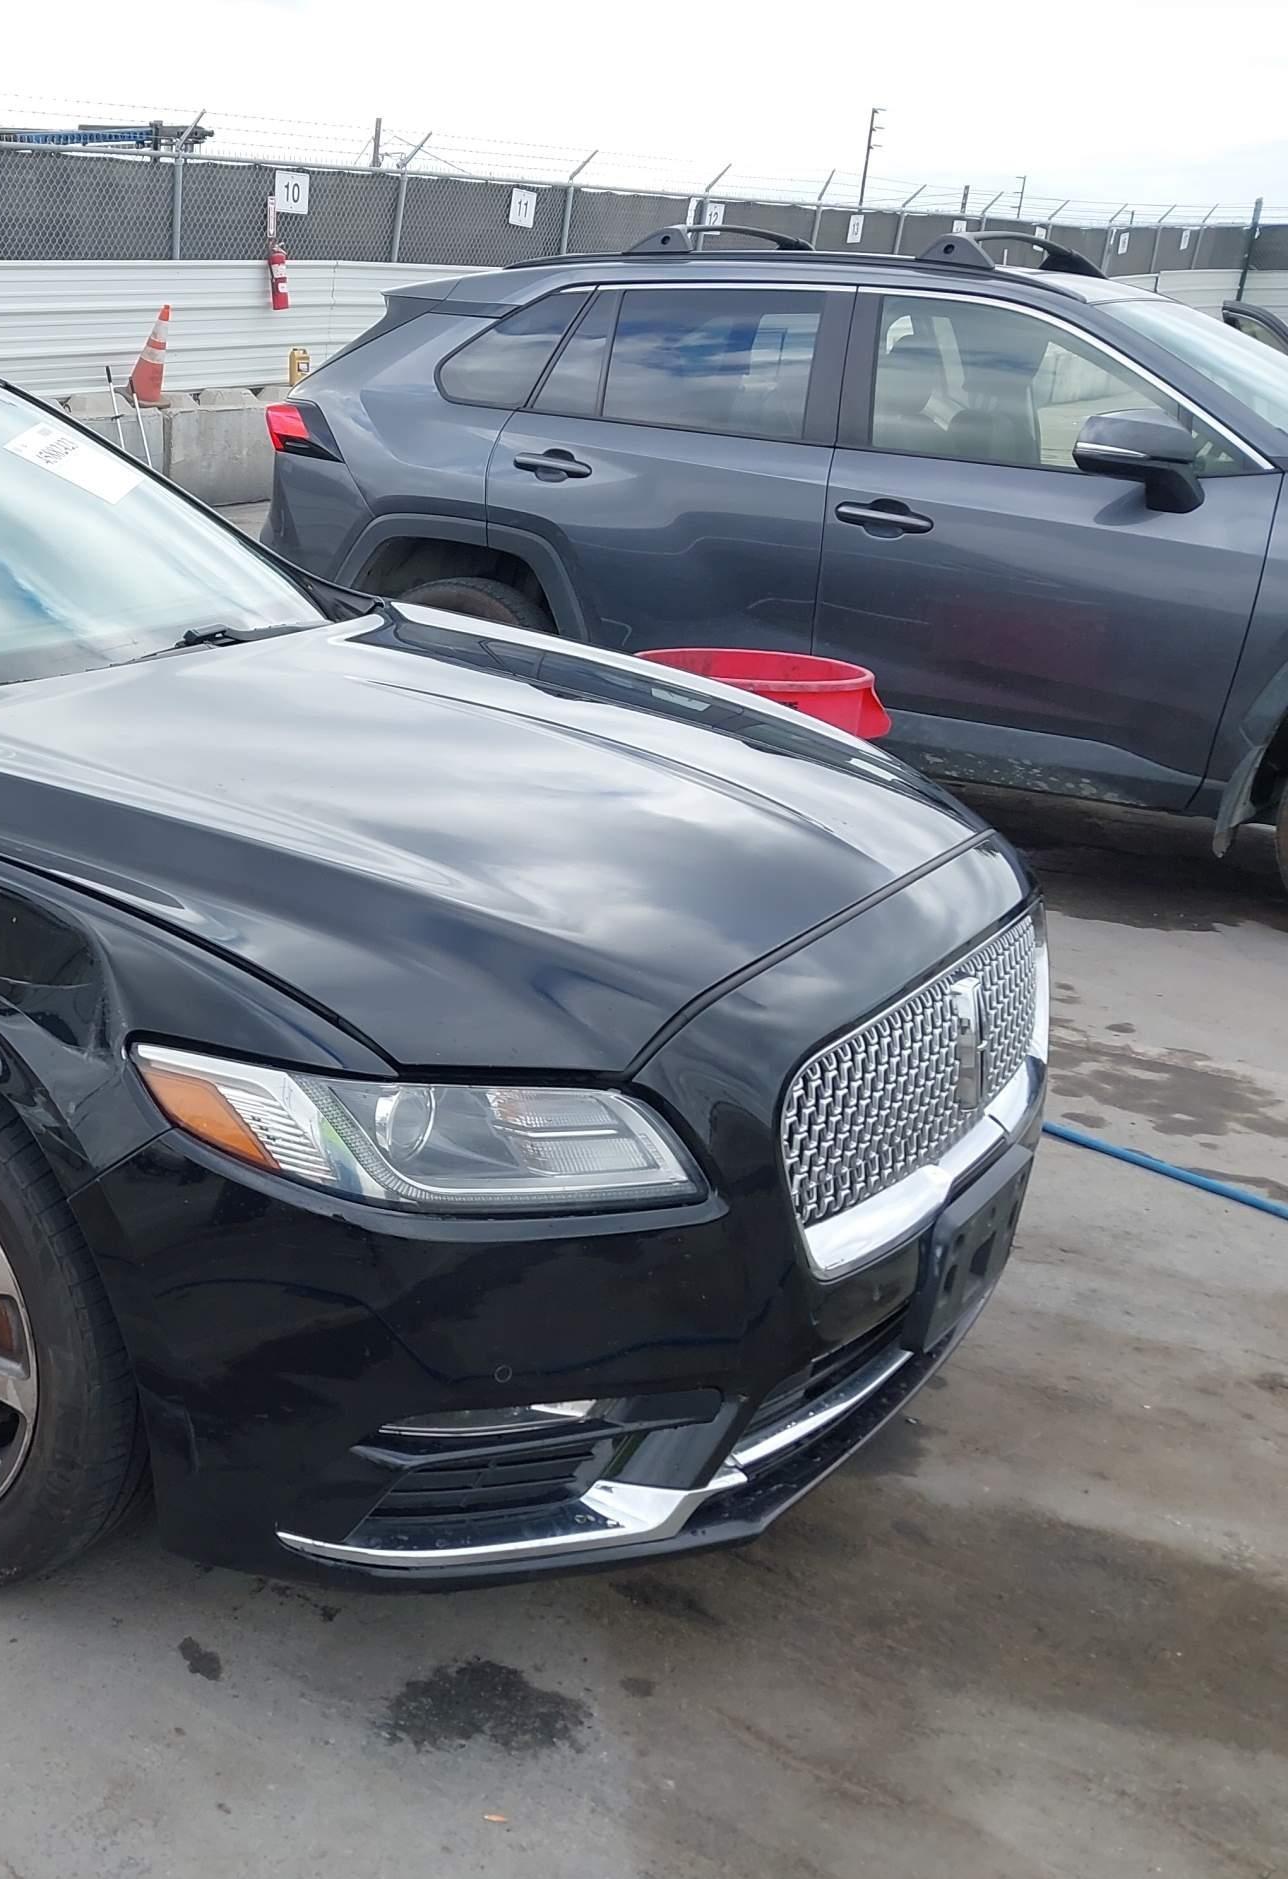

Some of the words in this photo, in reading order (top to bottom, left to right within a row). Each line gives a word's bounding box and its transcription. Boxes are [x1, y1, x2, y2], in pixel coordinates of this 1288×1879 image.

[284, 181, 300, 203] 10
[518, 199, 529, 218] 11
[708, 211, 719, 225] 12
